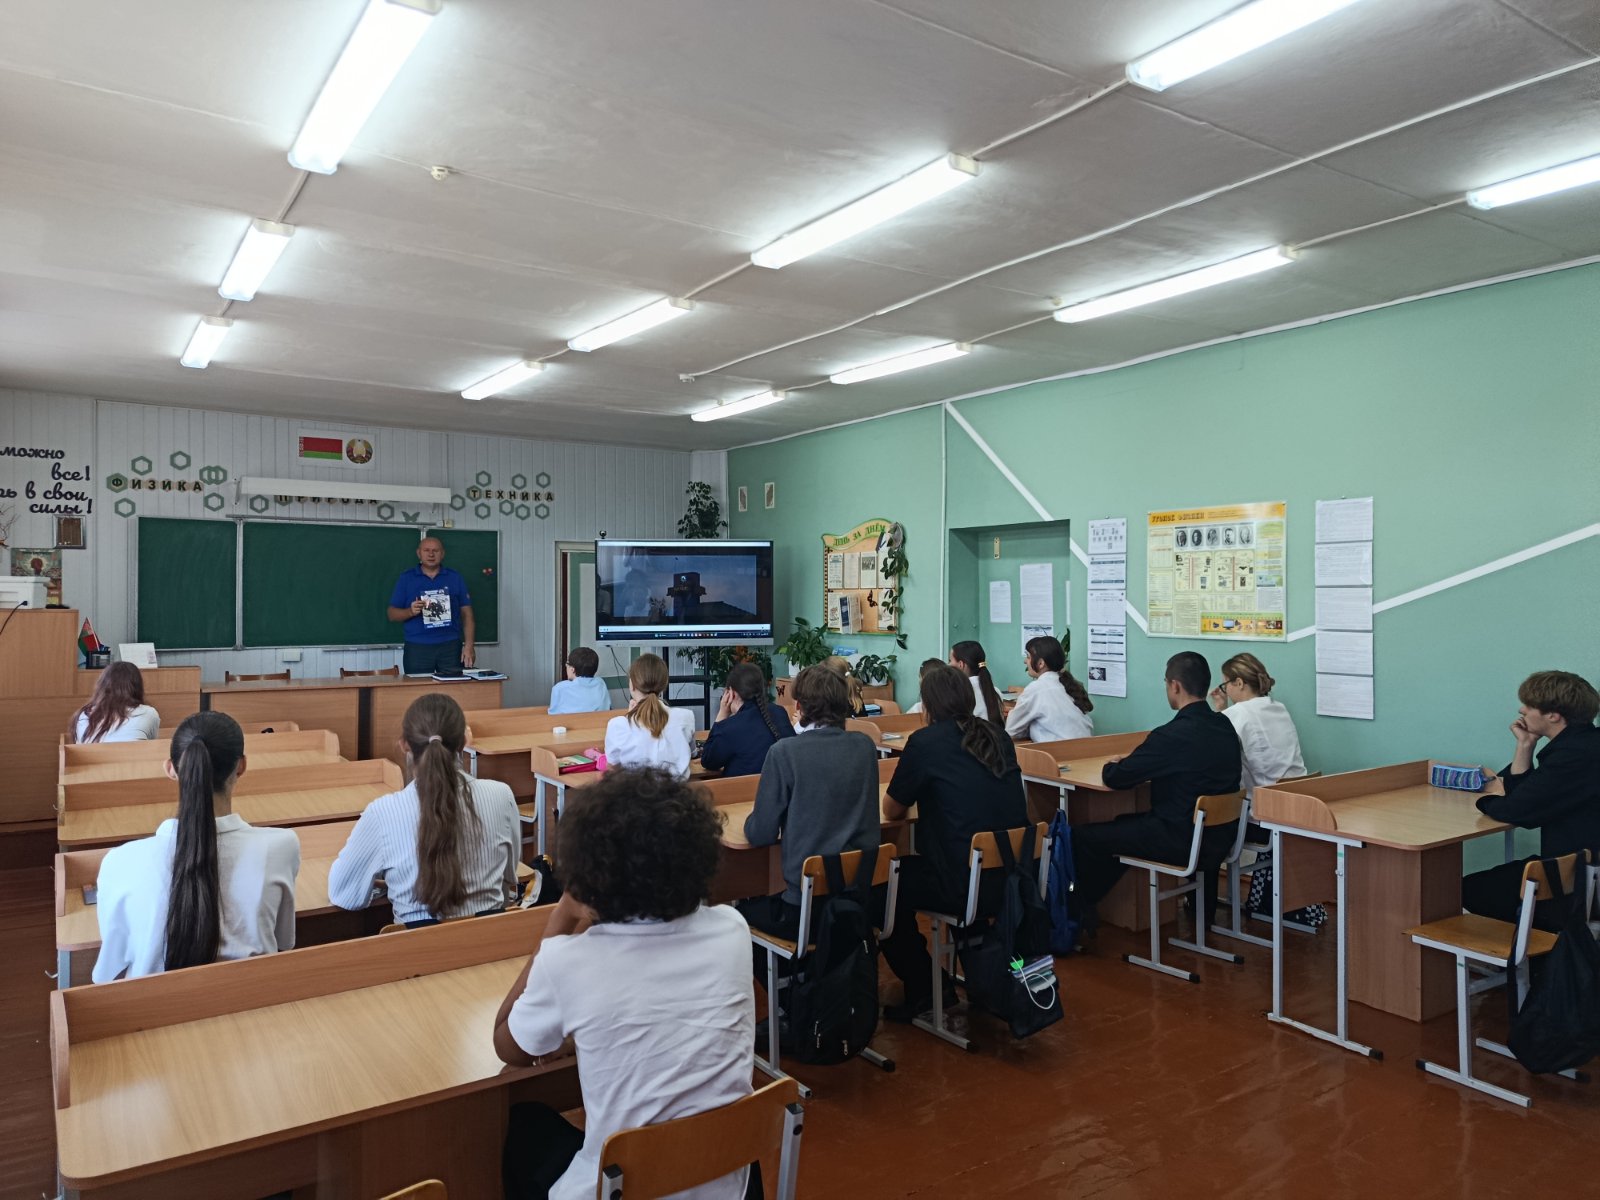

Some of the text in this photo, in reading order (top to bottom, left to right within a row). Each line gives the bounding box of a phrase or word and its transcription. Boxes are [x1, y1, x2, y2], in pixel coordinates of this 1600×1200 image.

[51, 462, 91, 481] все!
[25, 480, 36, 499] в
[43, 482, 88, 501] свои
[111, 478, 202, 492] ФИЗИКА
[471, 490, 553, 501] ТЕХНИКА
[29, 499, 93, 514] силы!
